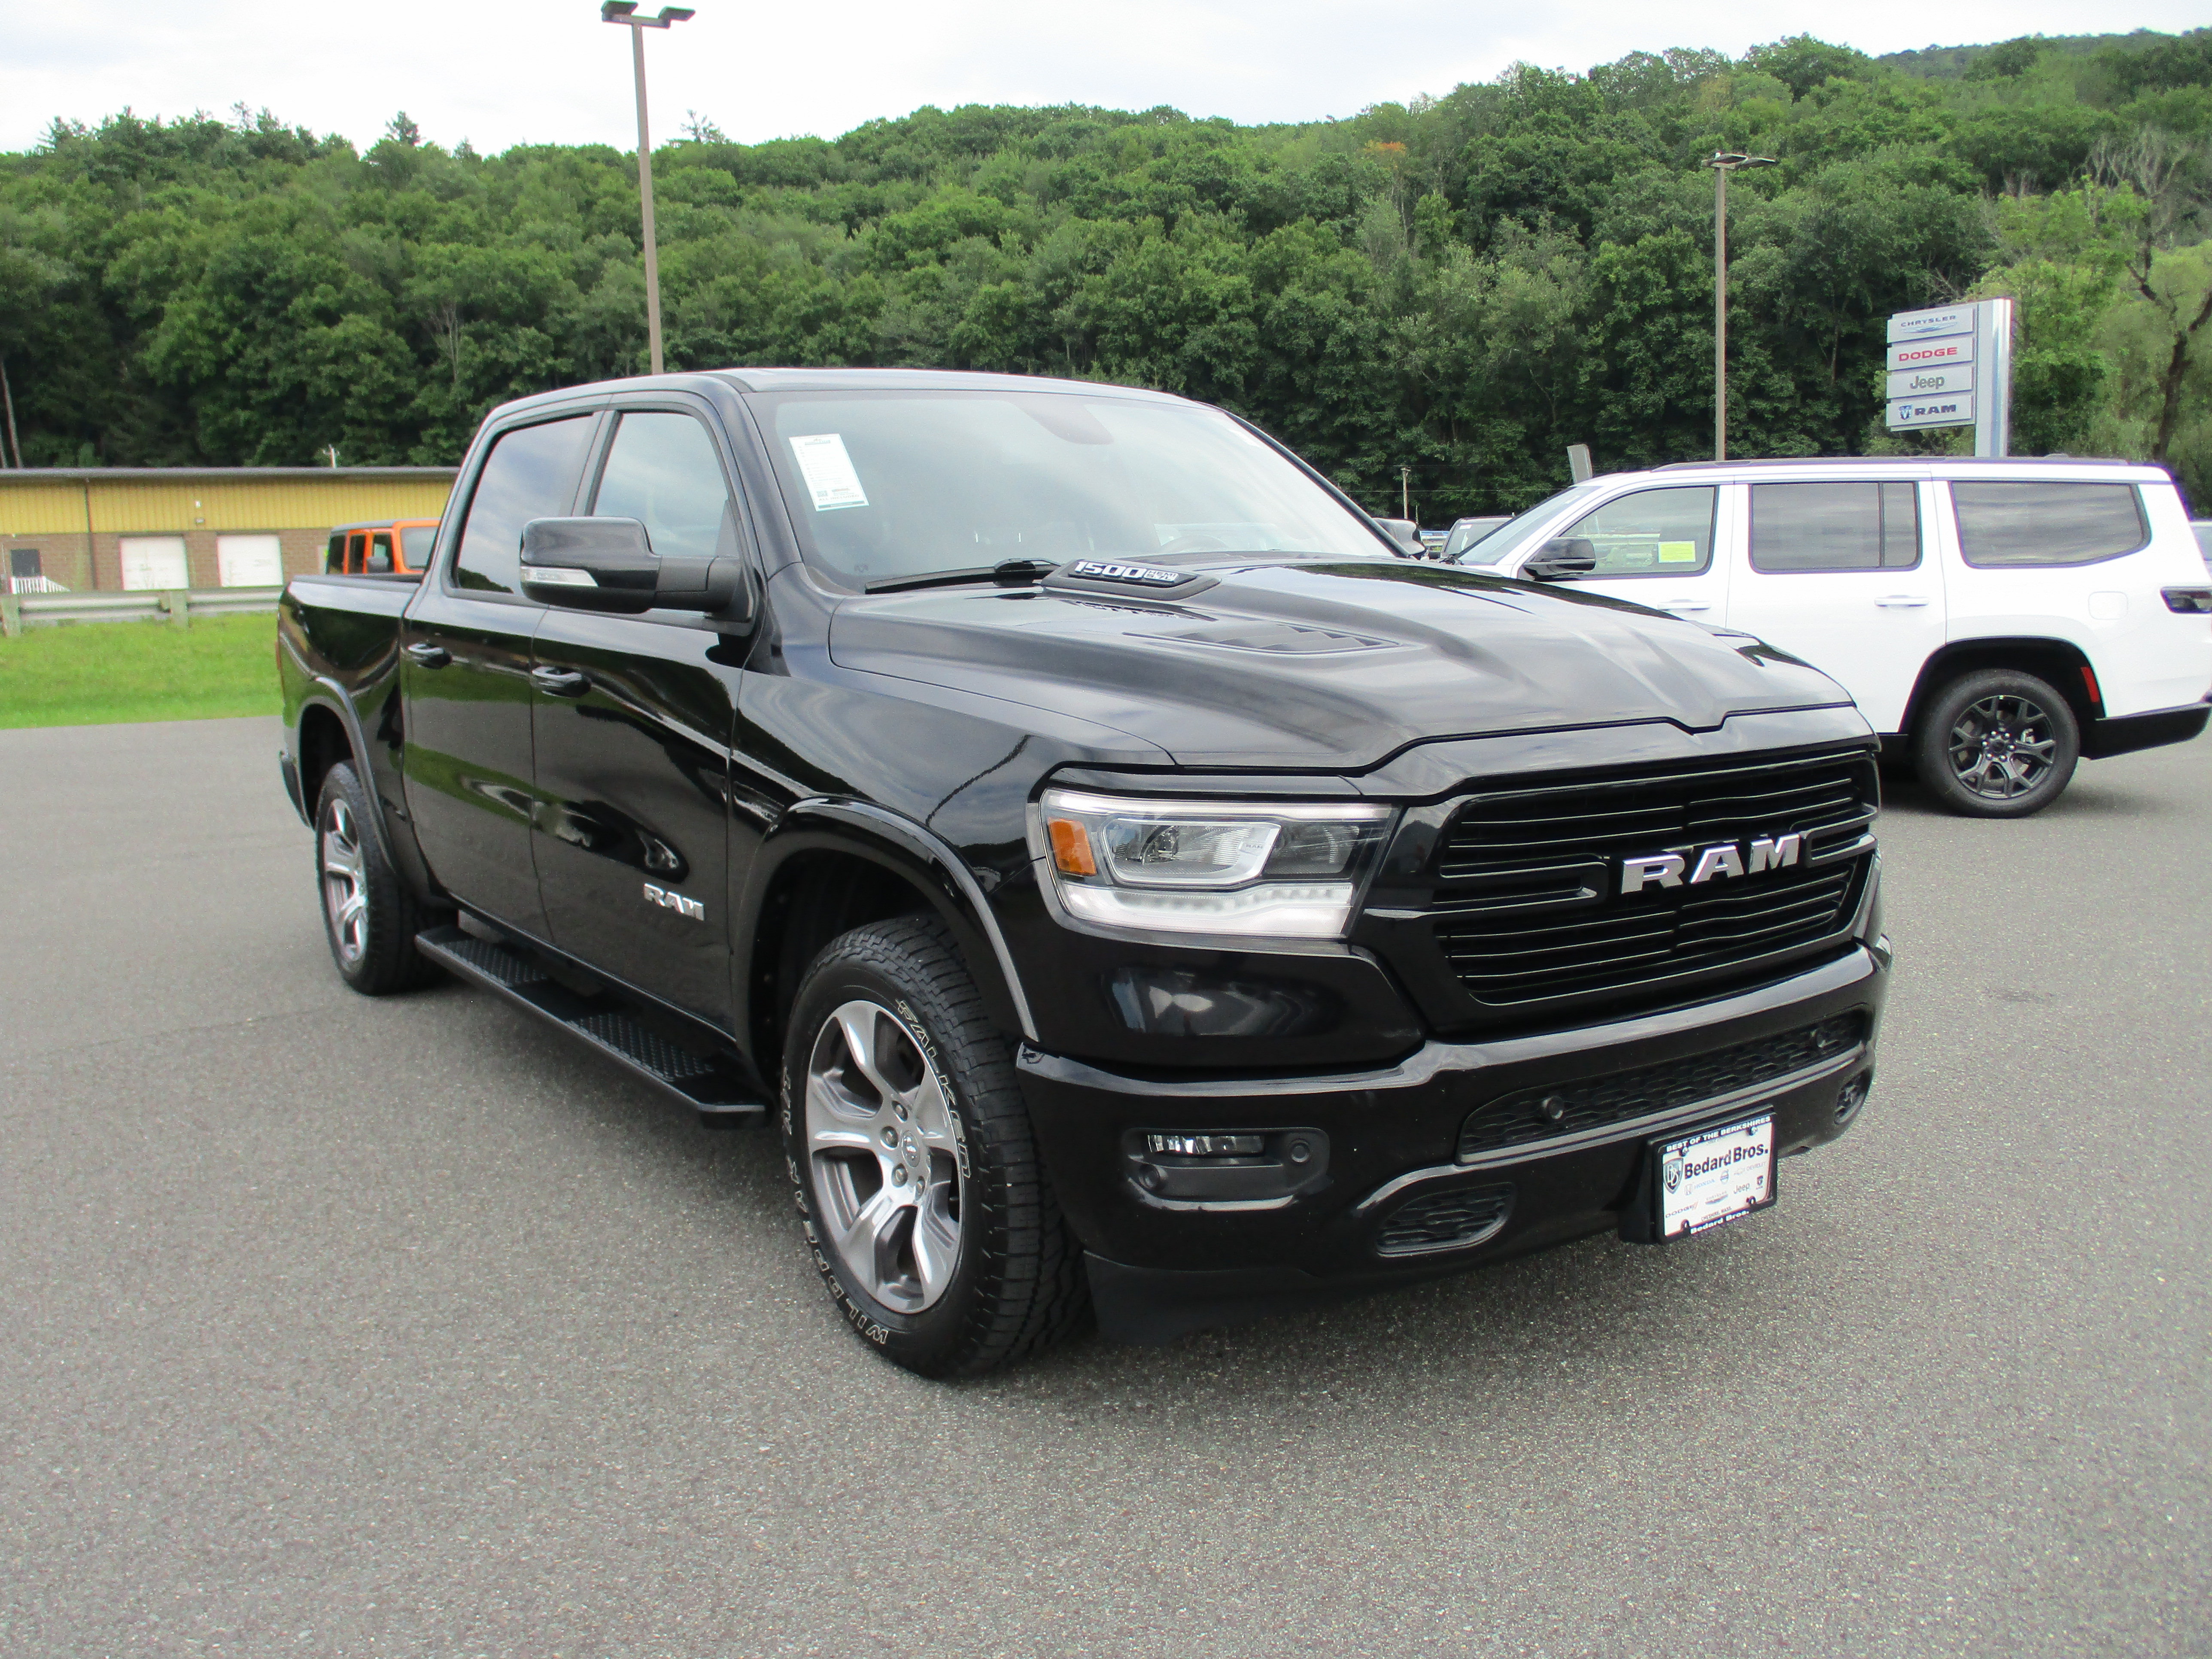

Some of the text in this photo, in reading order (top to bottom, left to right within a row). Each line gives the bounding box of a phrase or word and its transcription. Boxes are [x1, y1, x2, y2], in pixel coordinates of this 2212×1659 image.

[1900, 315, 1957, 327] CHRYSLER
[1899, 347, 1958, 362] DODGE
[1910, 375, 1945, 389] Jeep
[1914, 404, 1957, 416] RAM
[1074, 561, 1148, 579] 1500
[1621, 833, 1800, 895] RAM
[643, 882, 705, 921] RAM
[895, 999, 972, 1179] FALKEN
[1666, 1140, 1689, 1152] BEST
[1702, 1131, 1719, 1141] THE
[1720, 1116, 1771, 1136] BERKSHIRES
[1684, 1143, 1769, 1180] Bedard Bros.
[1694, 1178, 1715, 1189] HONDA
[1733, 1183, 1750, 1194] Jeep
[1665, 1205, 1694, 1218] DODGE
[1690, 1210, 1750, 1234] Bedard Bros.
